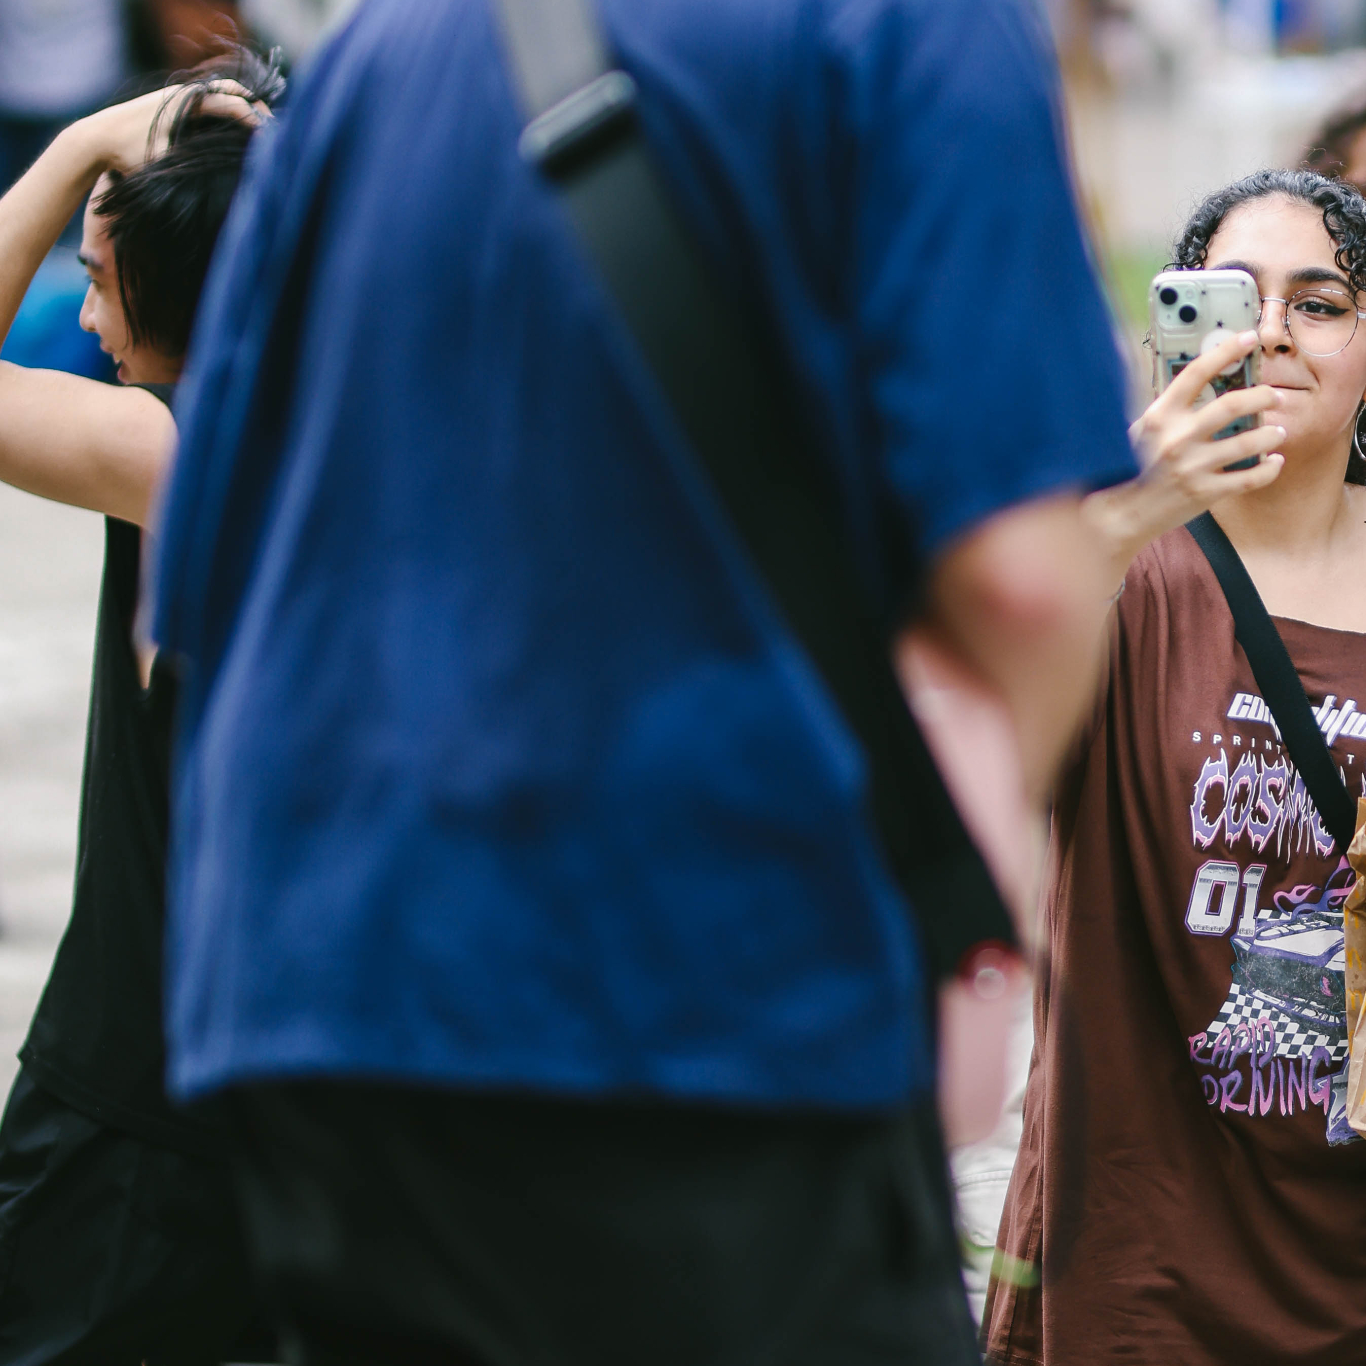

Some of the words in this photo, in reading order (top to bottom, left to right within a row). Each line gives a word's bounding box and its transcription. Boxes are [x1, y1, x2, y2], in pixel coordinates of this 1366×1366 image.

[1184, 859, 1268, 936] 01
[1188, 1016, 1276, 1069] RAPID
[1202, 1046, 1332, 1117] DRIVING
